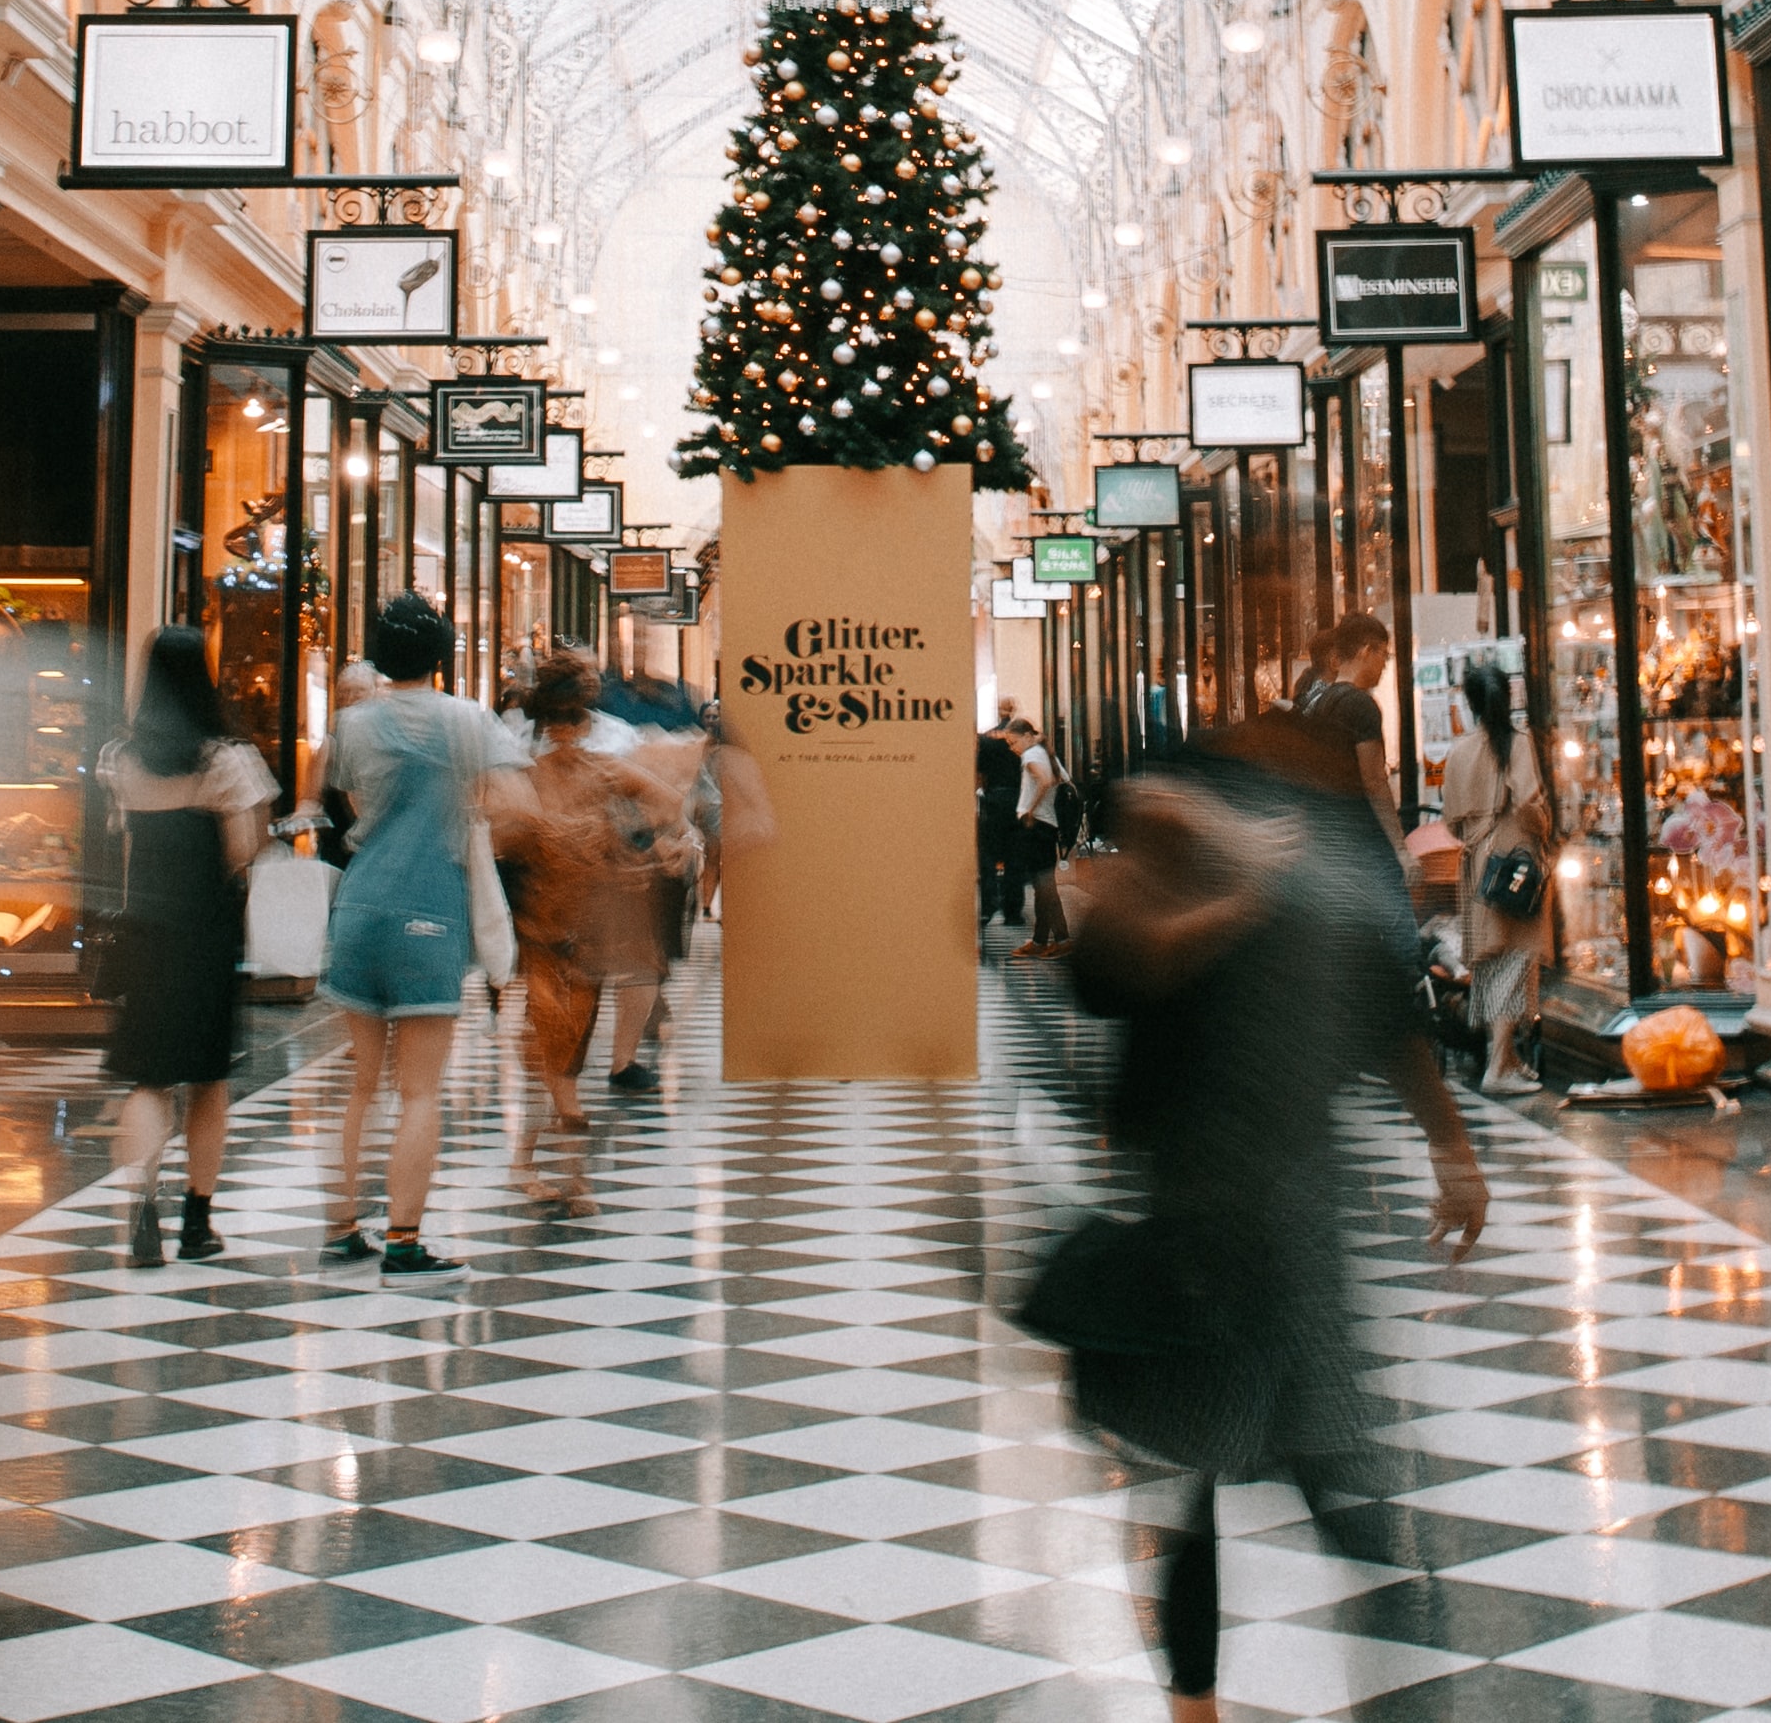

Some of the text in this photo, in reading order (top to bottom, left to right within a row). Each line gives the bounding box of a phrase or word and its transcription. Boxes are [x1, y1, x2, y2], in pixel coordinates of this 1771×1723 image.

[1542, 83, 1682, 111] CHOCAMAMA
[111, 110, 258, 145] habbot.
[740, 654, 894, 695] Sparkle
